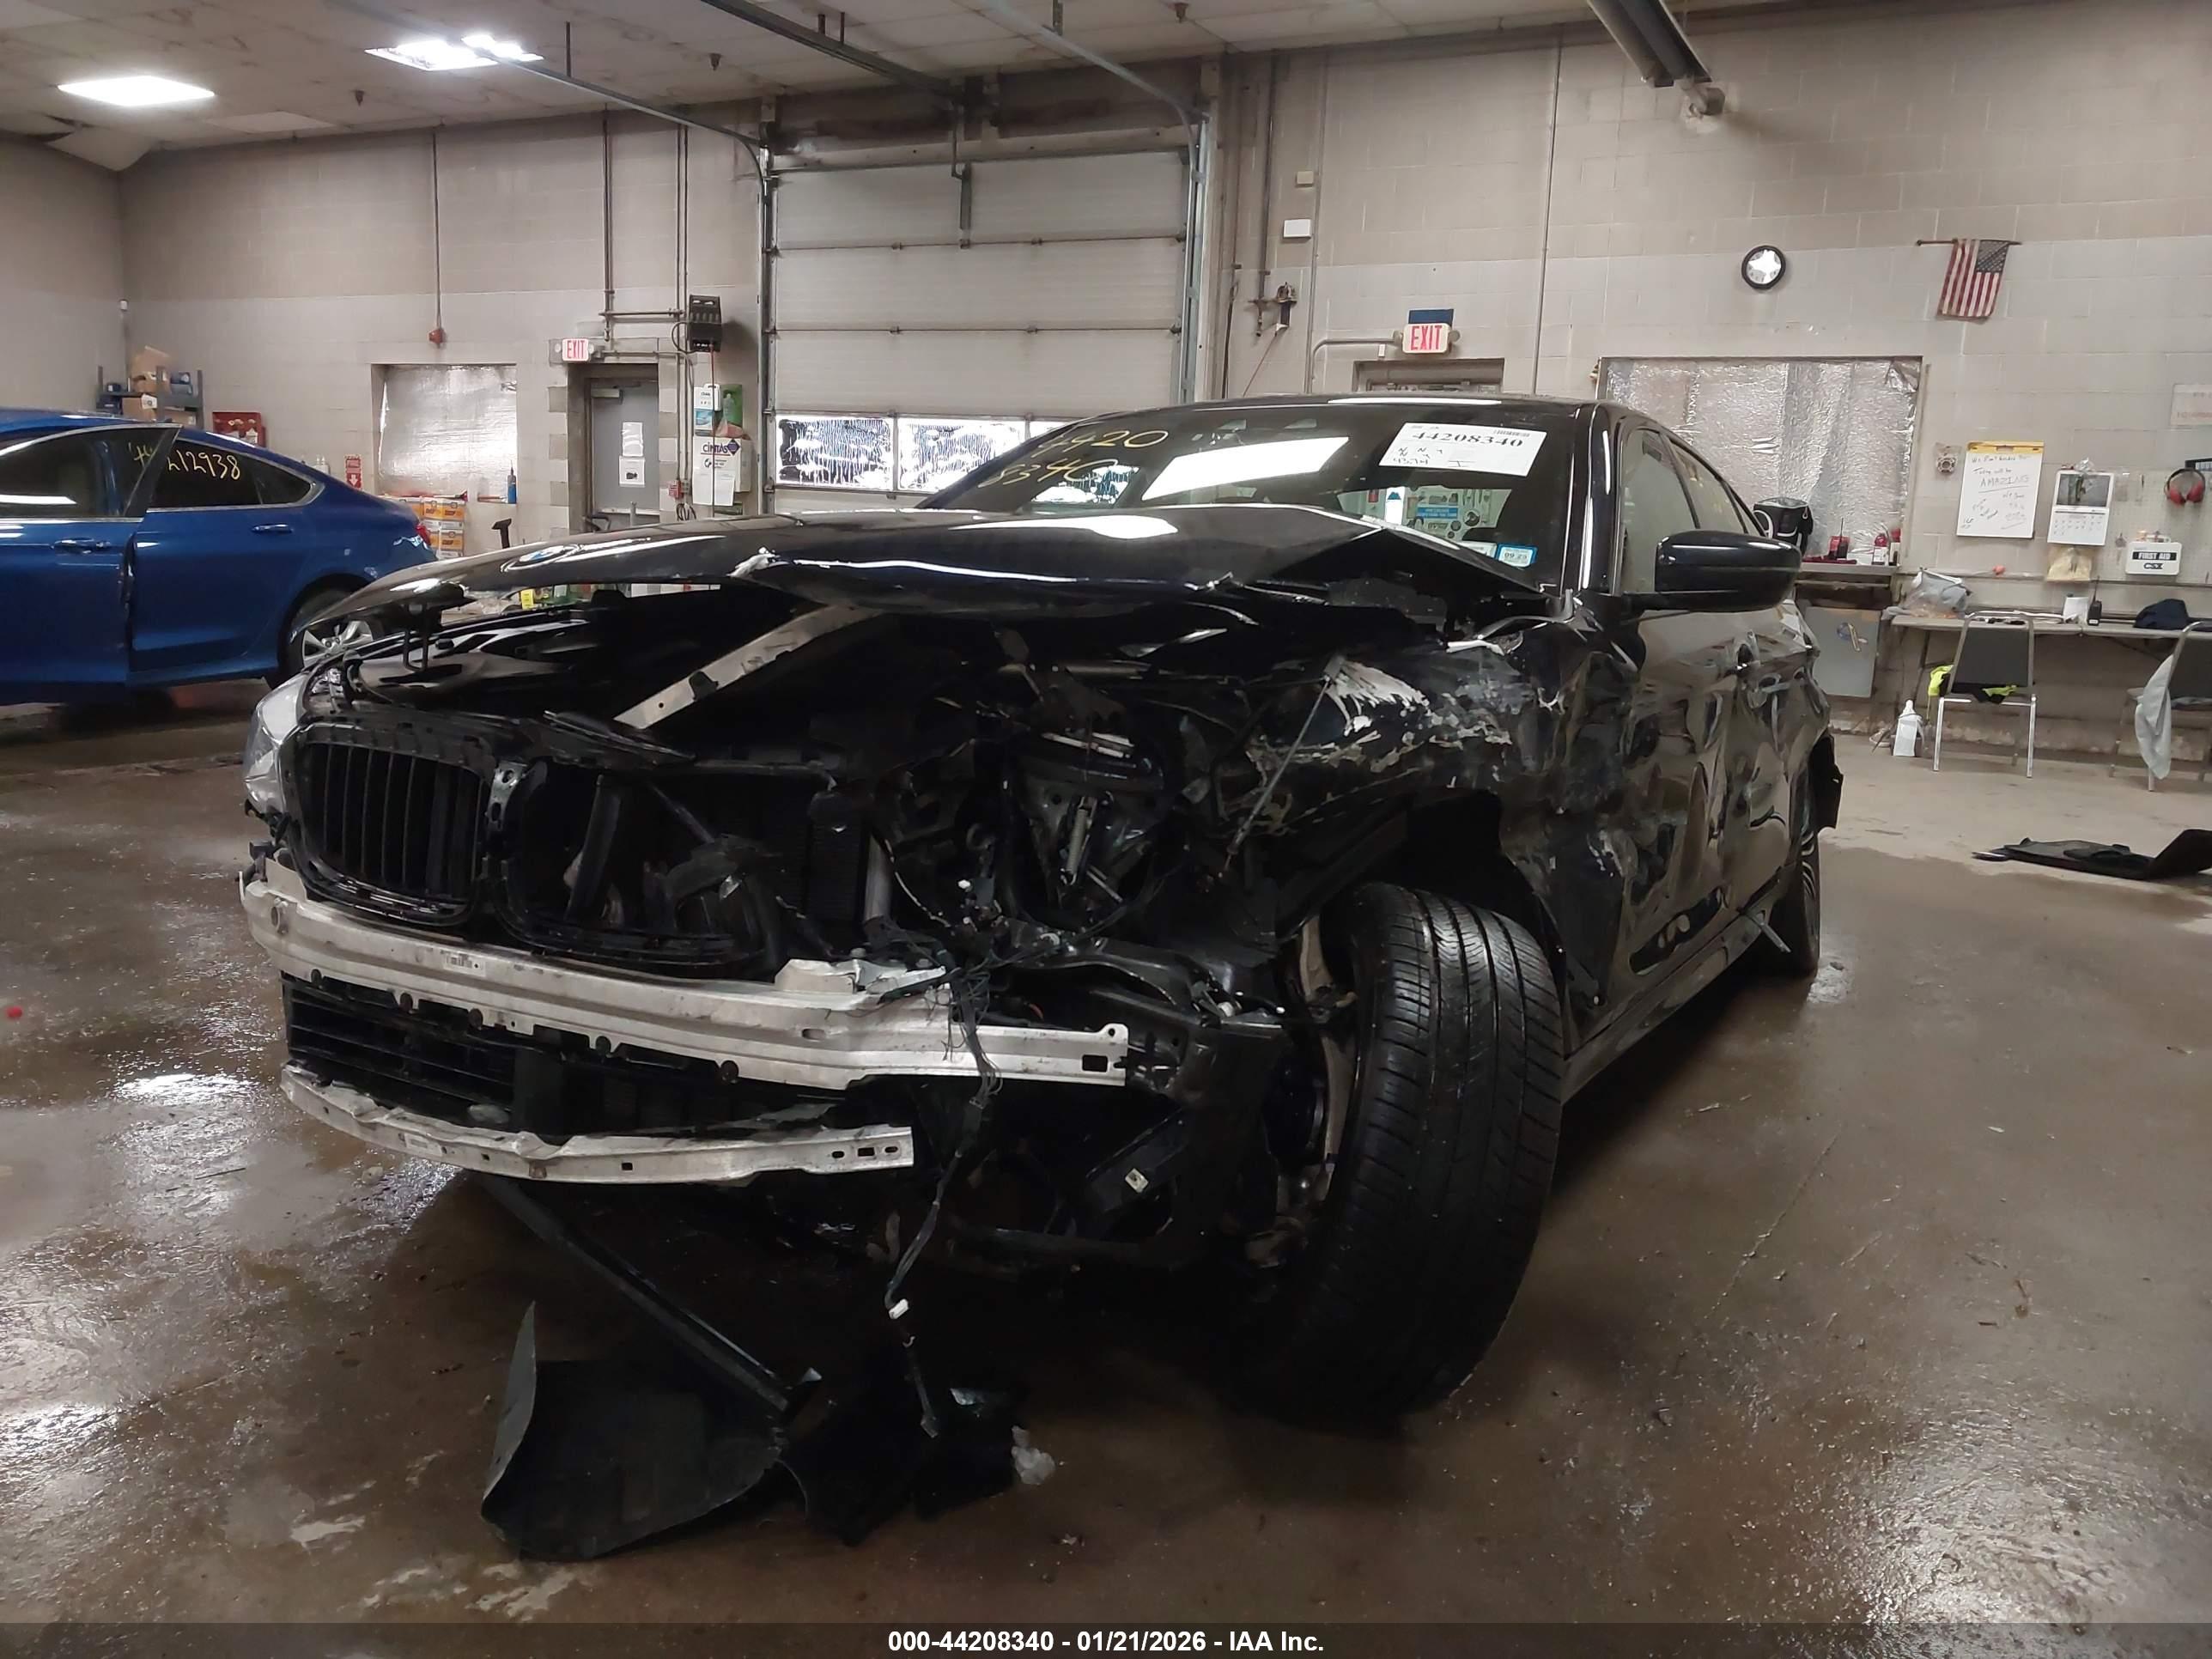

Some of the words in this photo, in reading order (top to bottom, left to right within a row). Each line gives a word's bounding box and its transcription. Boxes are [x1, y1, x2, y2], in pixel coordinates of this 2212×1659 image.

[1411, 325, 1443, 350] EXIT
[567, 340, 585, 359] EXIT
[702, 441, 728, 453] CINTAS
[1413, 431, 1523, 447] 44208340
[1980, 474, 2030, 487] AMAZING
